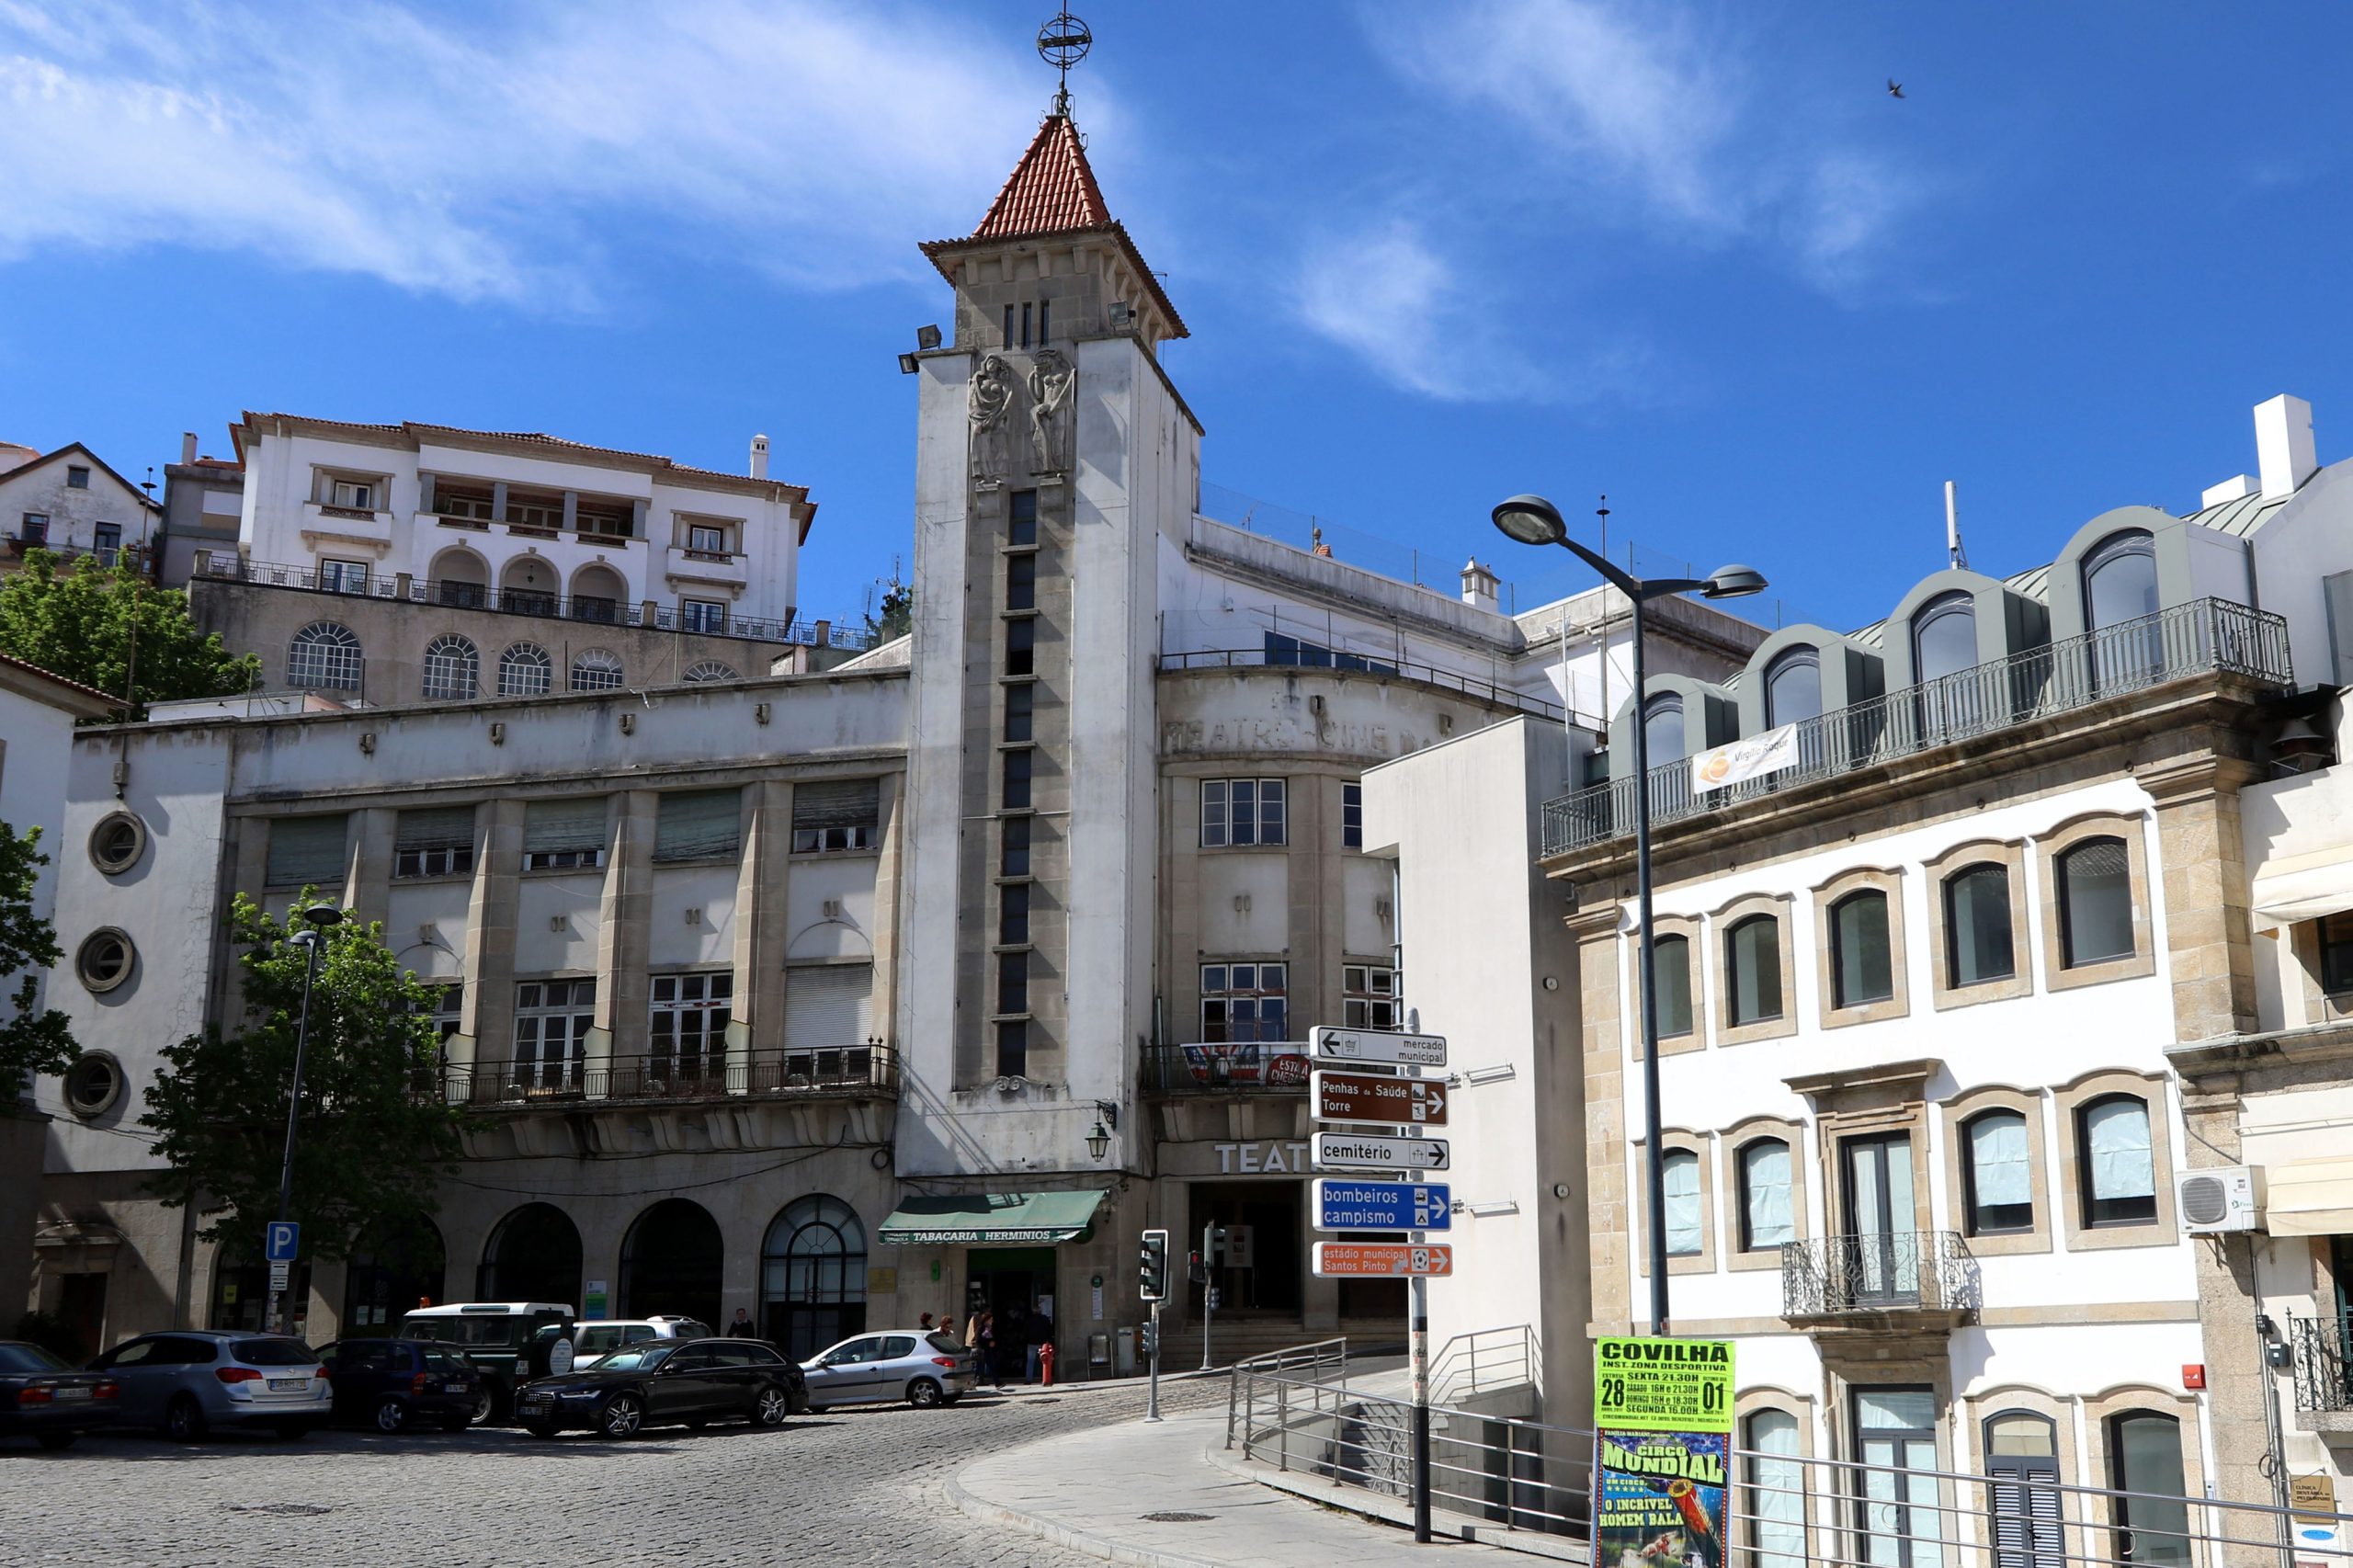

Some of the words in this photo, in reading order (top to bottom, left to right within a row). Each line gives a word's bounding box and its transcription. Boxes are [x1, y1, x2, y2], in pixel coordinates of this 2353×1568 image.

[1764, 739, 1789, 752] Roque
[1404, 1040, 1443, 1051] mercado
[1398, 1051, 1443, 1063] municipal
[1322, 1081, 1358, 1095] Penhas
[1375, 1085, 1407, 1097] Saúde
[1323, 1099, 1350, 1111] Torre
[1324, 1143, 1392, 1160] cemitério
[1324, 1187, 1398, 1203] bombeiros
[1324, 1209, 1395, 1226] campismo
[273, 1226, 292, 1256] P
[913, 1232, 978, 1242] TABACARIA
[984, 1231, 1051, 1241] HERMINIOS
[1324, 1248, 1359, 1259] estádio
[1363, 1249, 1407, 1260] municipal
[1324, 1261, 1358, 1271] Santos
[1362, 1261, 1387, 1271] Pinto
[1602, 1342, 1729, 1363] COVILHÃ
[1660, 1363, 1727, 1372] DESPORTIVA
[1627, 1372, 1659, 1381] SEXTA
[1662, 1373, 1699, 1382] 21.30H
[1601, 1379, 1625, 1407] 28
[1651, 1384, 1665, 1393] 16H
[1666, 1385, 1671, 1393] e
[1673, 1384, 1699, 1394] 21.30H
[1626, 1394, 1650, 1404] DOMINGO
[1651, 1395, 1665, 1405] 16H
[1673, 1396, 1699, 1405] 18.30H
[1702, 1381, 1724, 1410] 01
[1626, 1404, 1666, 1414] SEGUNDA
[1668, 1405, 1699, 1415] 16.00H
[1636, 1446, 1687, 1457] CIRCO
[1602, 1440, 1724, 1484] MUNDIAL
[1605, 1499, 1614, 1511] O
[1616, 1496, 1673, 1511] INCRÍVEL
[1598, 1513, 1645, 1527] HOMEM
[1648, 1512, 1685, 1527] BALA
